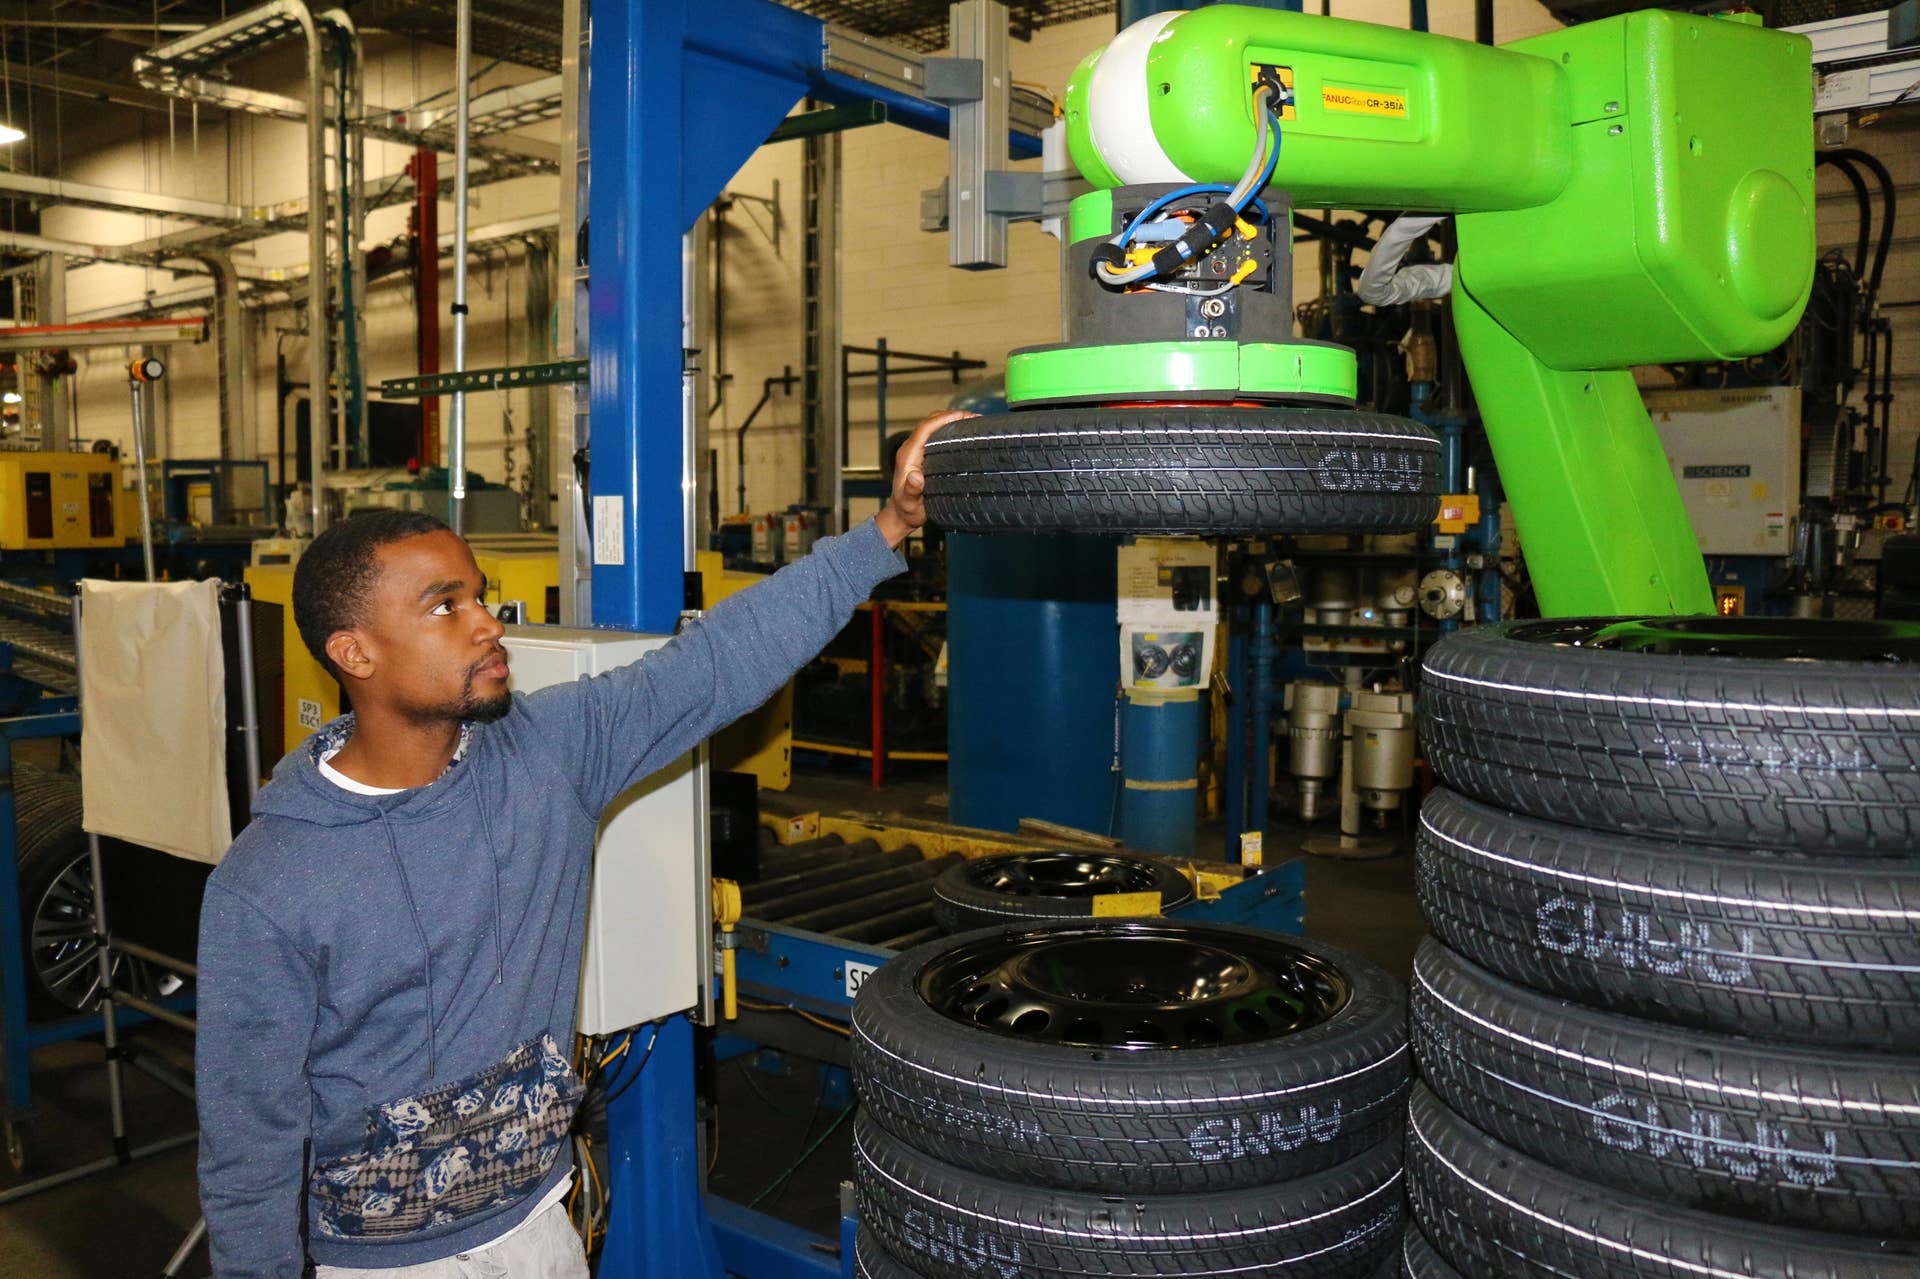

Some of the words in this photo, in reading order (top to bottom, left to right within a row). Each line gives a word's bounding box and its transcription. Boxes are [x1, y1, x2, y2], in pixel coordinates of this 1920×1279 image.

[1322, 93, 1352, 105] FANUC
[1366, 97, 1405, 111] CR-35iA
[1694, 466, 1748, 478] SCHENCK
[302, 701, 318, 715] SP3
[300, 714, 320, 728] ESC1
